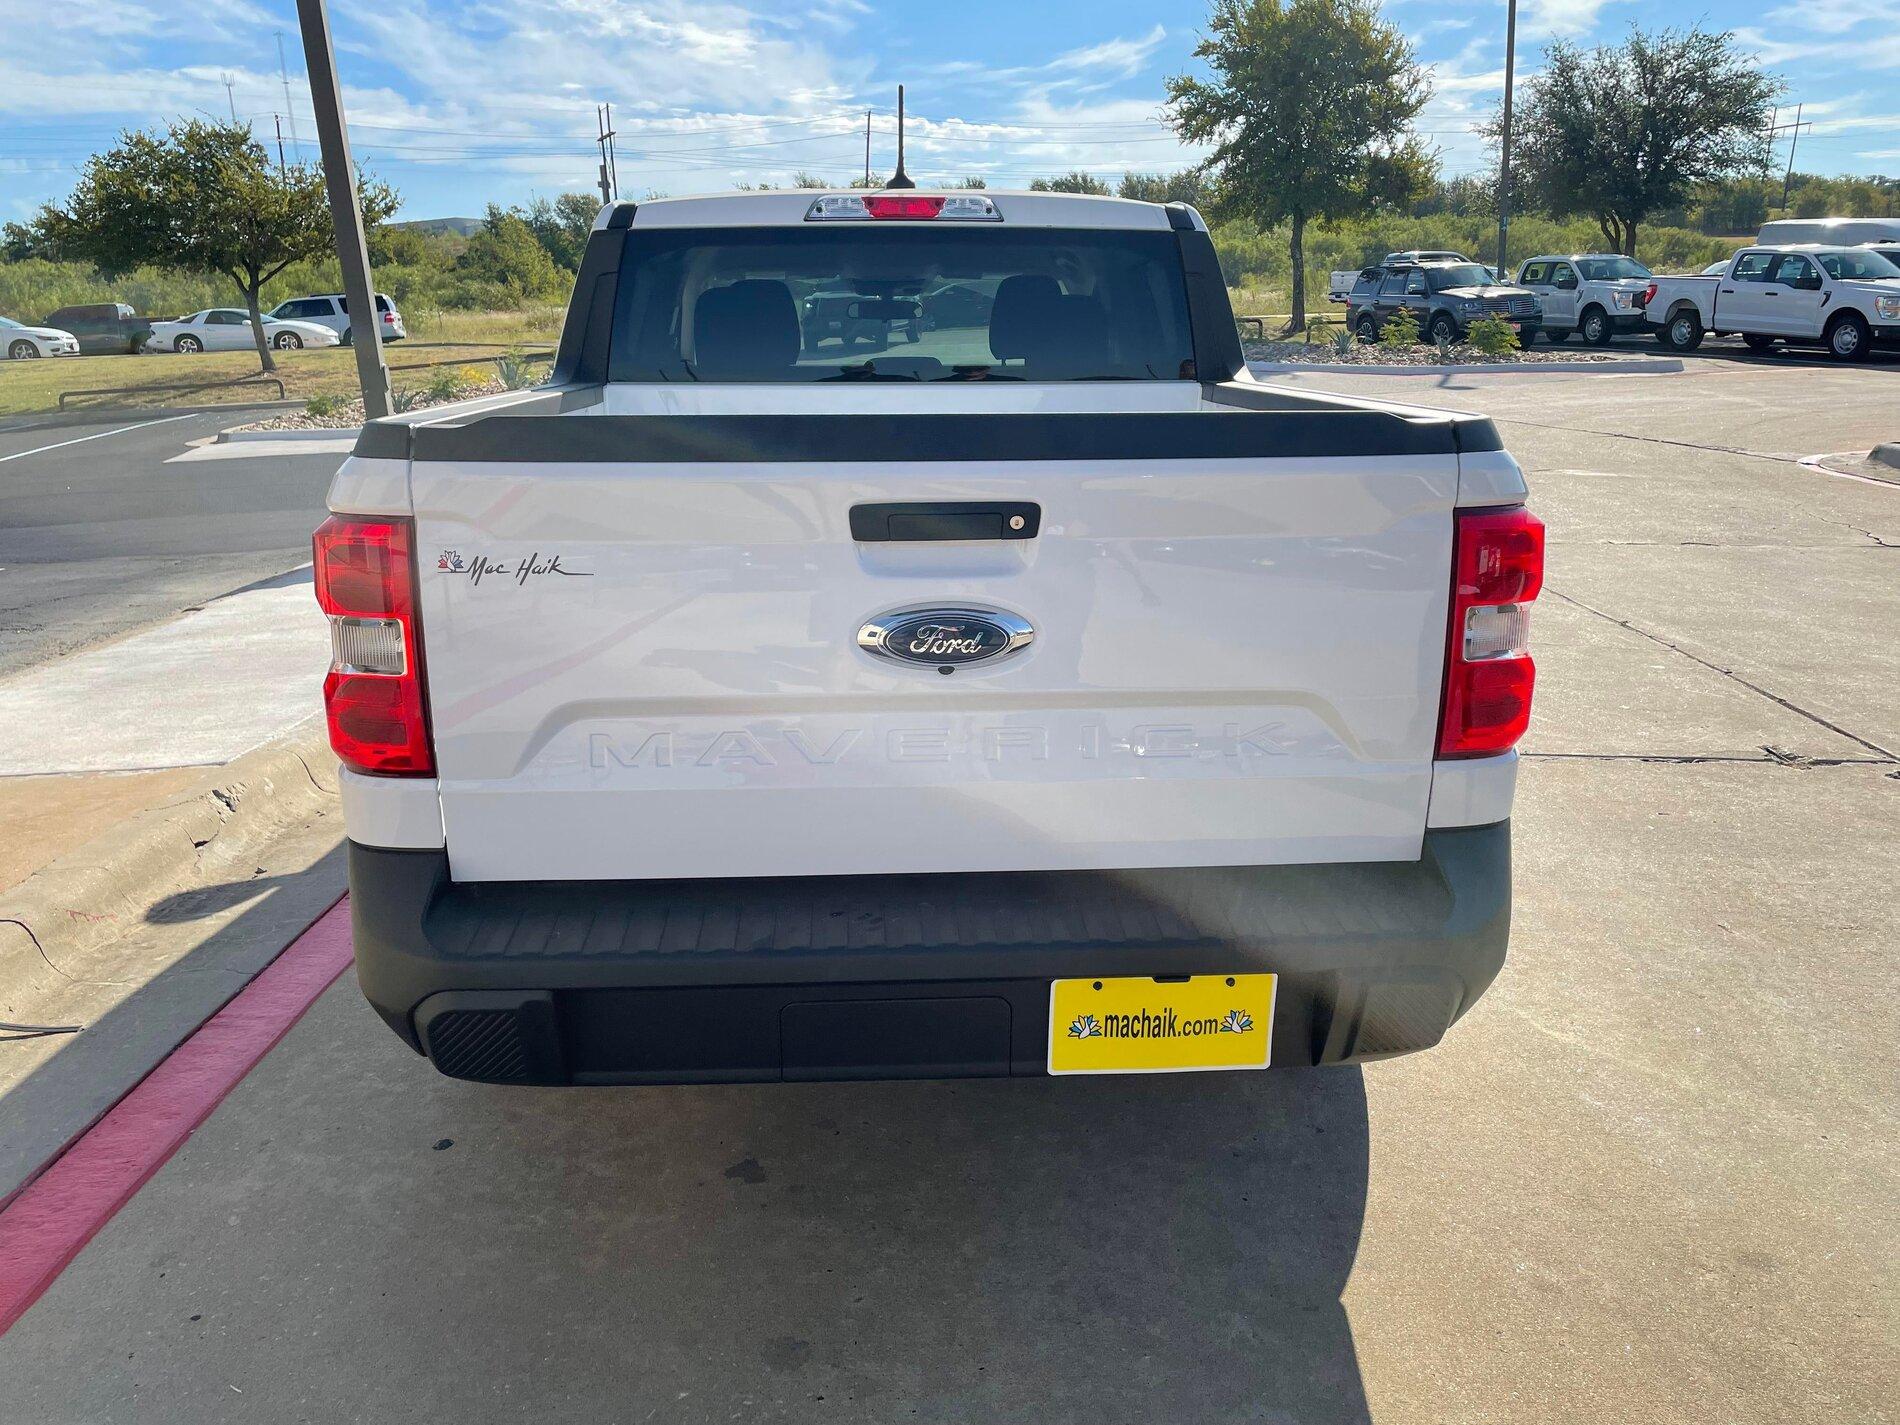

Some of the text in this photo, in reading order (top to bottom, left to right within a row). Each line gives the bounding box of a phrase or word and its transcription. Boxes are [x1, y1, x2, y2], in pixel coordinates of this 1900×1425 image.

[467, 552, 594, 586] Mac Haik
[909, 624, 982, 654] Ford
[589, 721, 1290, 768] MAVERICK
[1104, 1007, 1218, 1039] machaik.com
